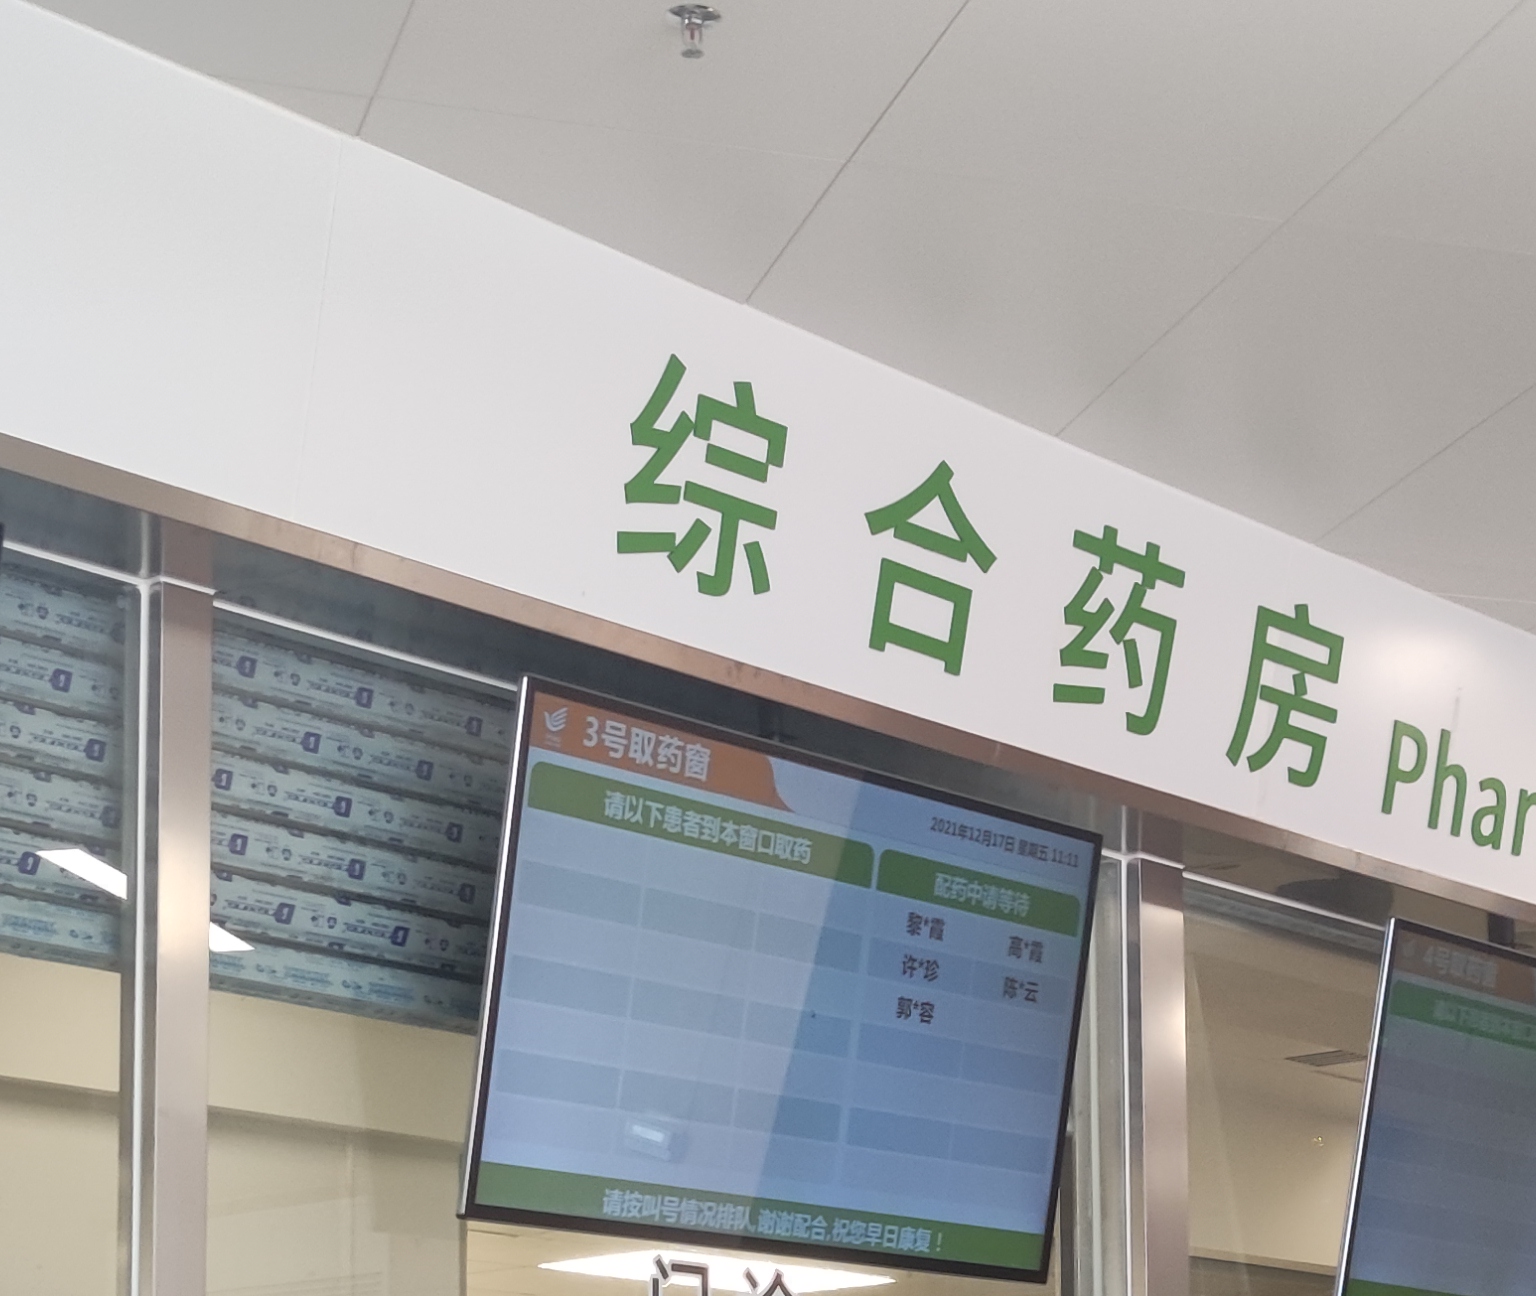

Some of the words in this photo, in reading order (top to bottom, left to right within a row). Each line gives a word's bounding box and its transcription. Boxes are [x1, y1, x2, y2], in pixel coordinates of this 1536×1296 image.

[615, 353, 1346, 789] 综合药房
[582, 715, 711, 783] 3号取药窗
[604, 790, 812, 865] 请以下患者到本窗口取药
[930, 816, 1015, 853] 2021年12月17日
[1018, 839, 1049, 862] 星期五
[933, 872, 1032, 918] 配药中请等待
